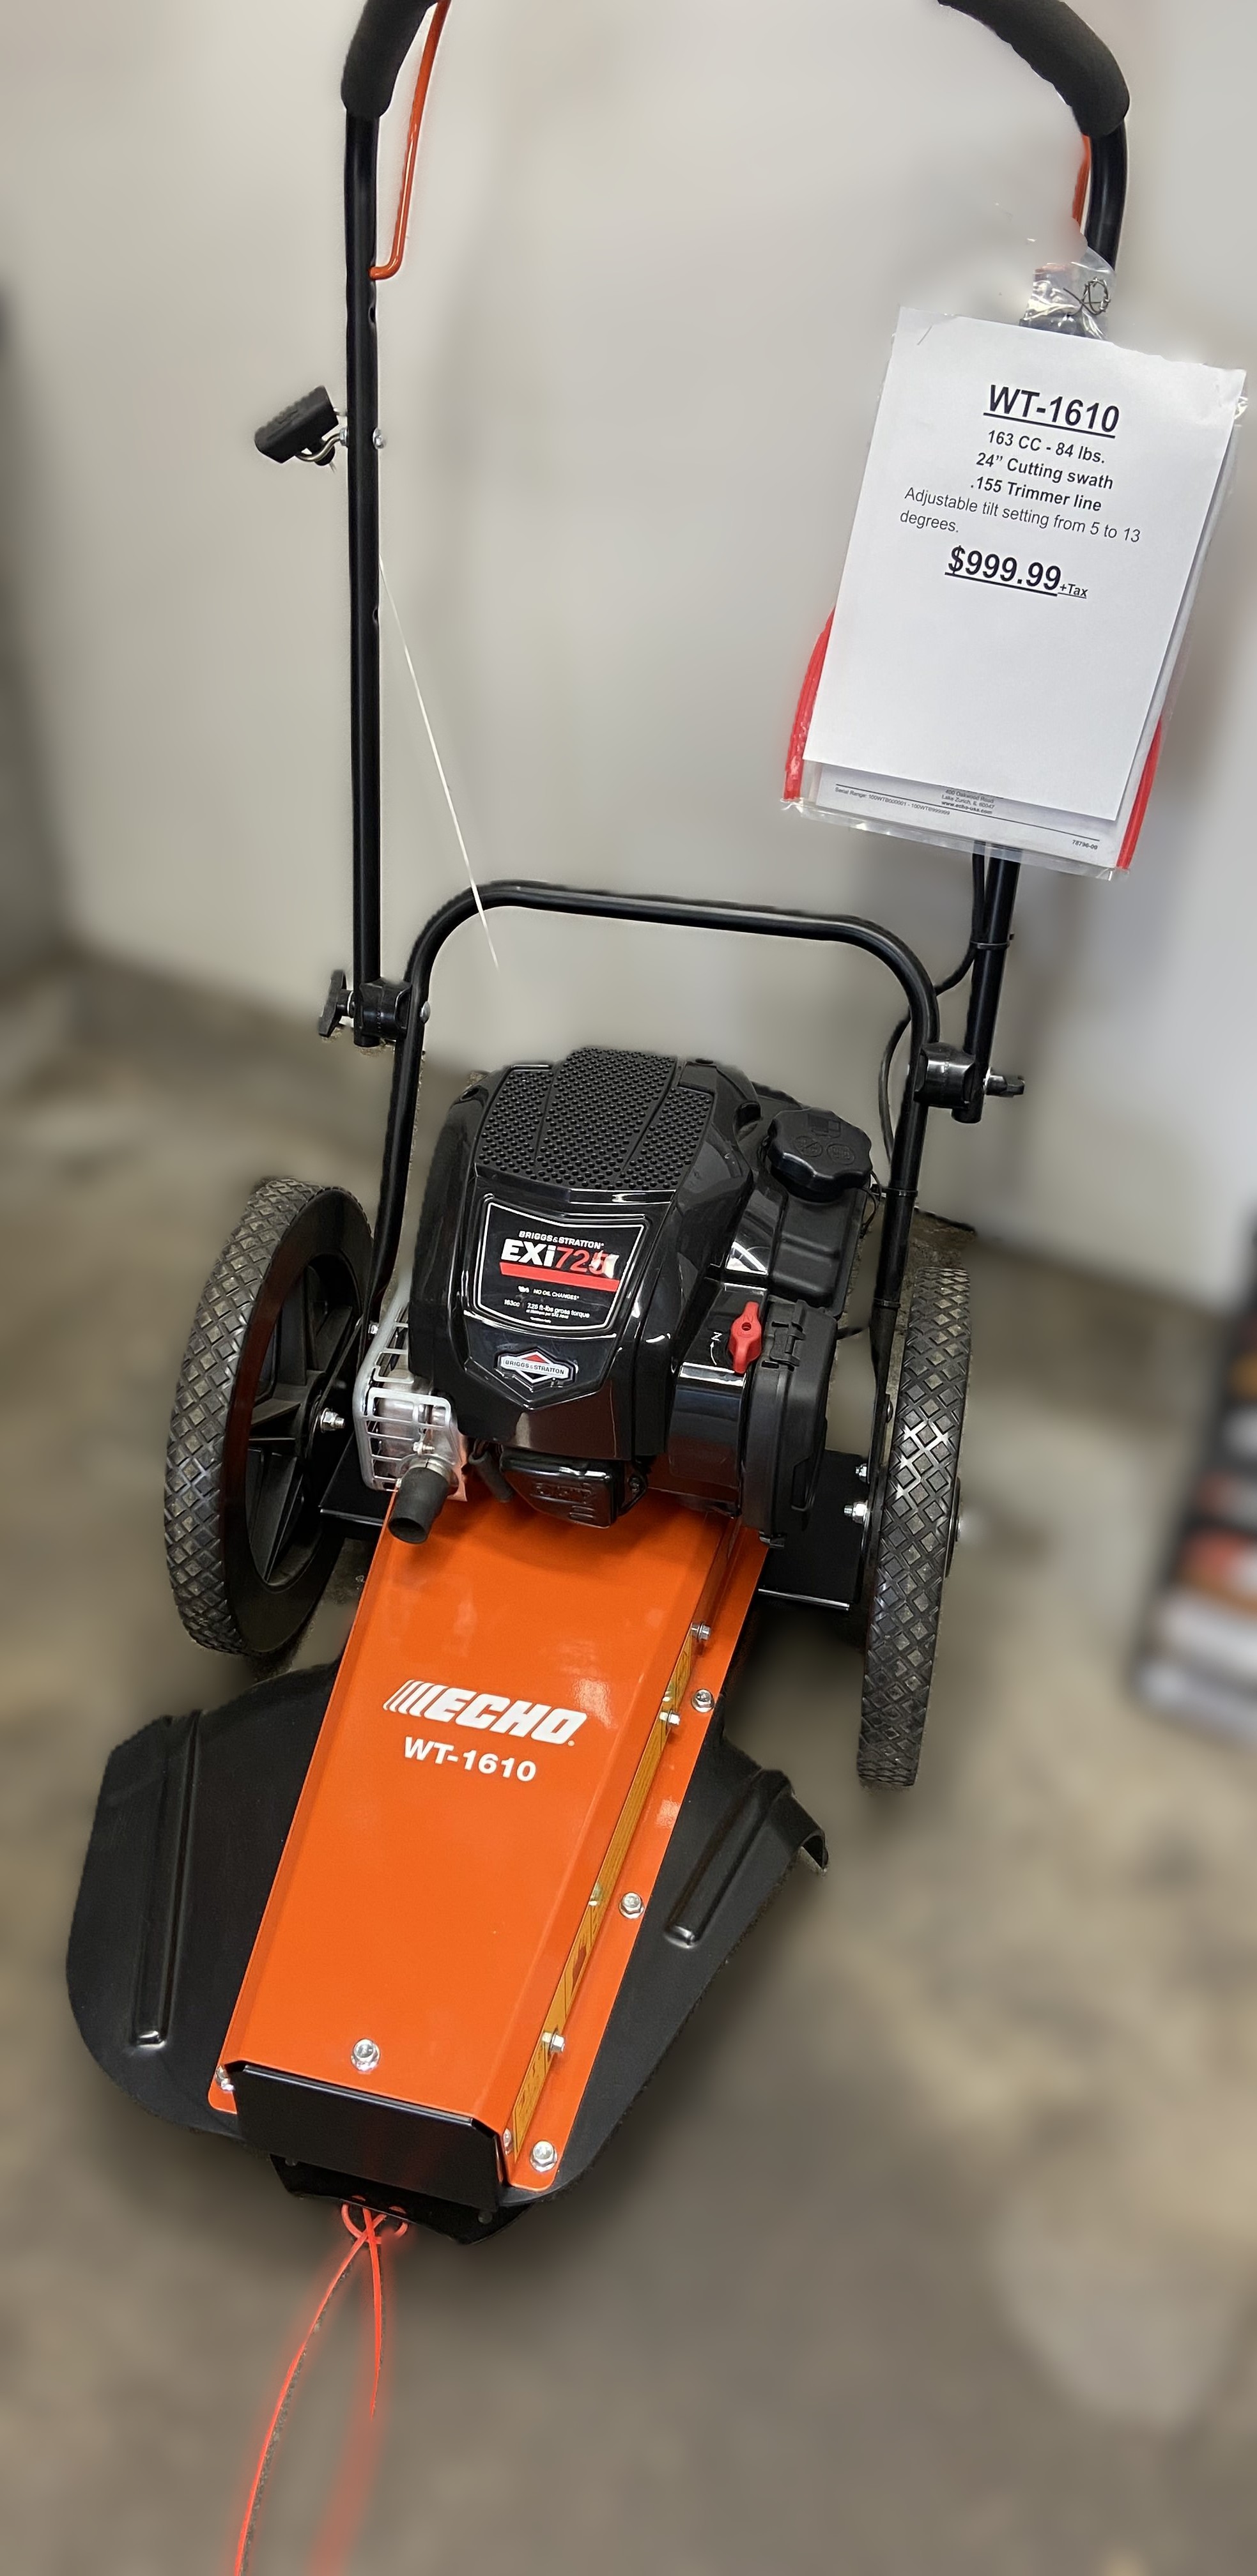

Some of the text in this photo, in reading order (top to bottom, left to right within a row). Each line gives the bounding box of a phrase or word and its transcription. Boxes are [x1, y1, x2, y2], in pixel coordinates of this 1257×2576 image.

[989, 384, 1120, 433] WT-1610
[988, 430, 1014, 447] 163
[1019, 436, 1042, 451] CC
[1056, 442, 1074, 457] 84
[1078, 446, 1105, 464] lbs.
[971, 477, 1102, 512] .155 Trimmer line
[1007, 458, 1063, 483] Cutting
[1067, 472, 1113, 489] swath
[900, 510, 959, 533] degrees.
[904, 487, 1141, 542] Adjustable tilt setting from 5 to 13
[948, 545, 1061, 590] $999.99
[424, 1687, 587, 1745] ECHO
[404, 1736, 536, 1782] WT-1610
